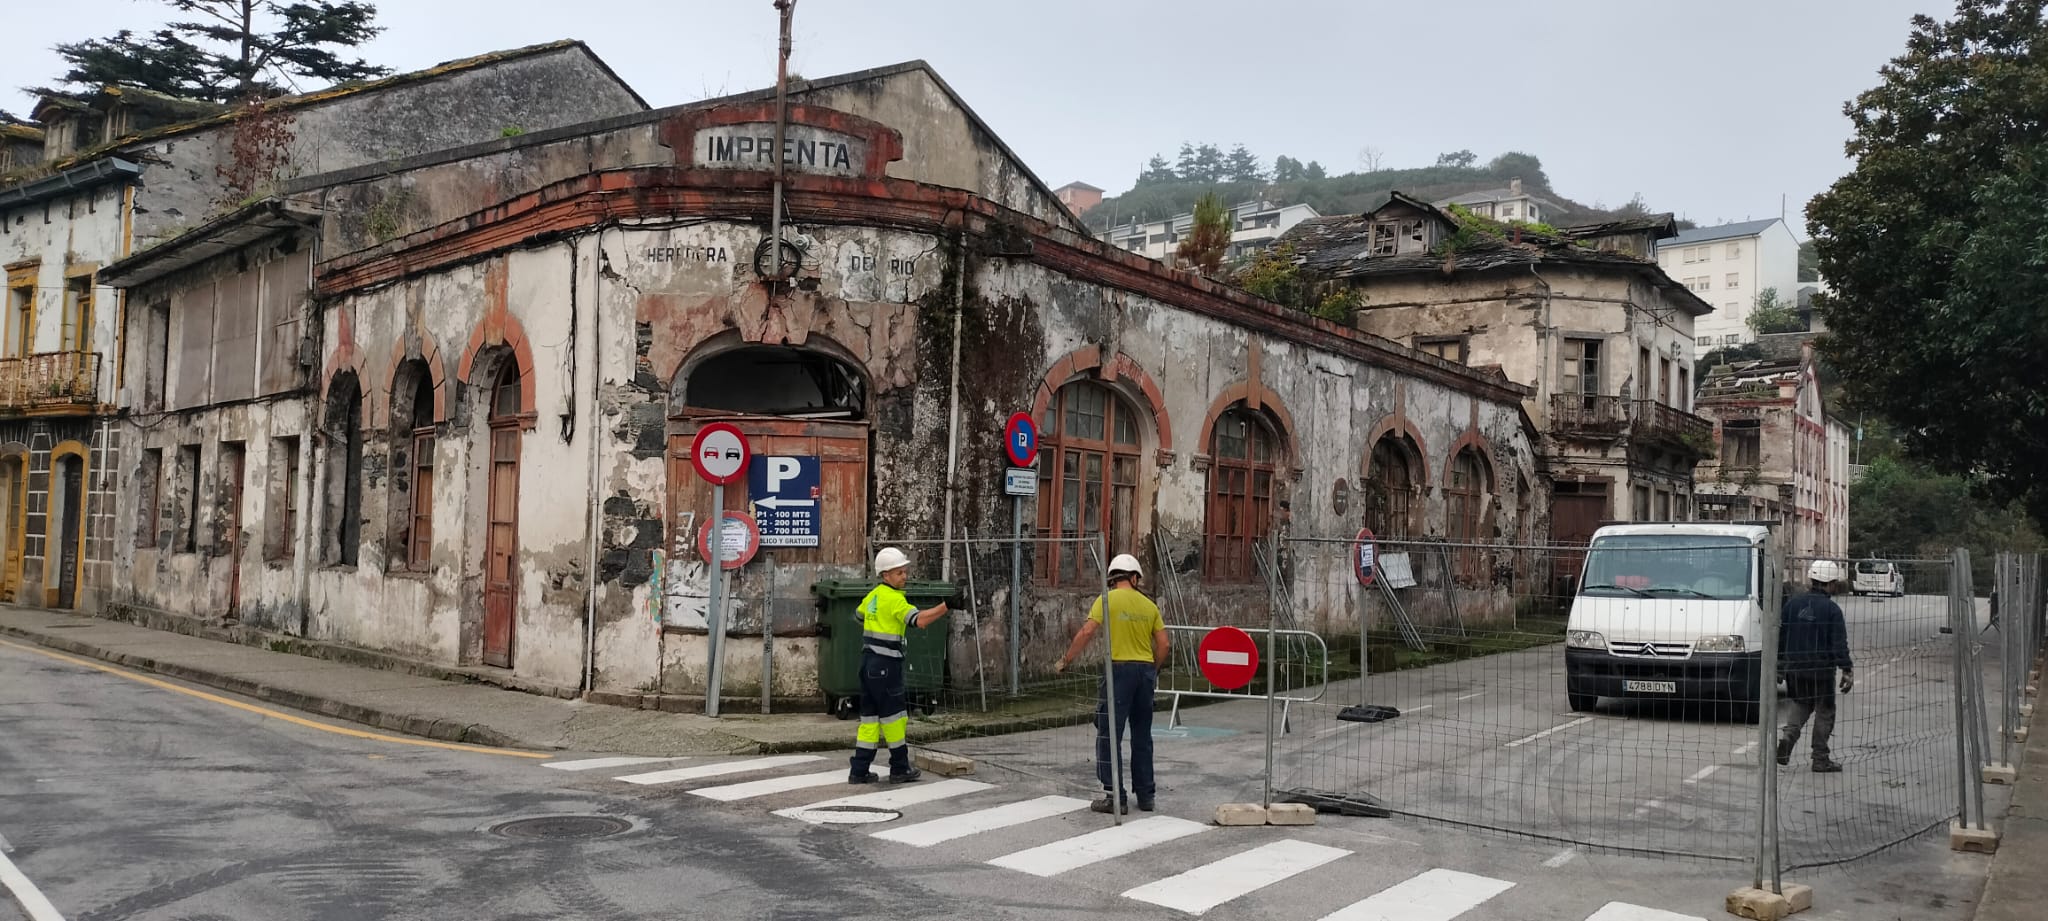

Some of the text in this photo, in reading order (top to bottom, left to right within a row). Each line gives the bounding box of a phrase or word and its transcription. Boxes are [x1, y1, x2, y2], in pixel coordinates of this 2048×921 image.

[708, 135, 851, 170] IMPRENTA
[891, 258, 915, 276] RIO
[767, 456, 801, 493] P
[792, 511, 811, 519] MTS
[791, 527, 811, 535] MTS
[1629, 681, 1652, 691] 4788
